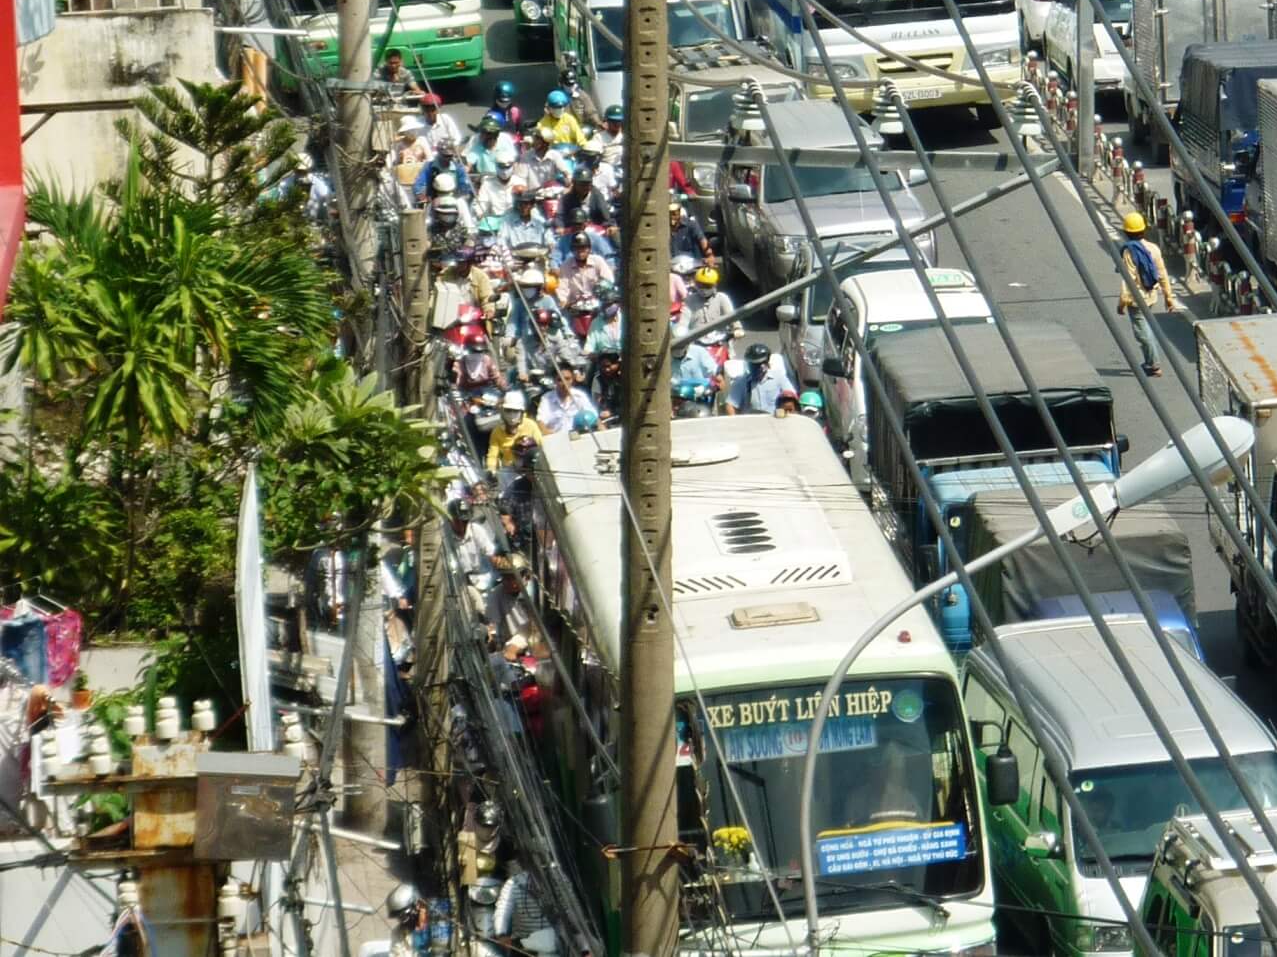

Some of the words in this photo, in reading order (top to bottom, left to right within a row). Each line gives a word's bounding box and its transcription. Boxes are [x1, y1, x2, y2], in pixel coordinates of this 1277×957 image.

[707, 705, 735, 729] XE
[739, 694, 790, 726] BUÝT
[846, 685, 892, 718] HIỆP
